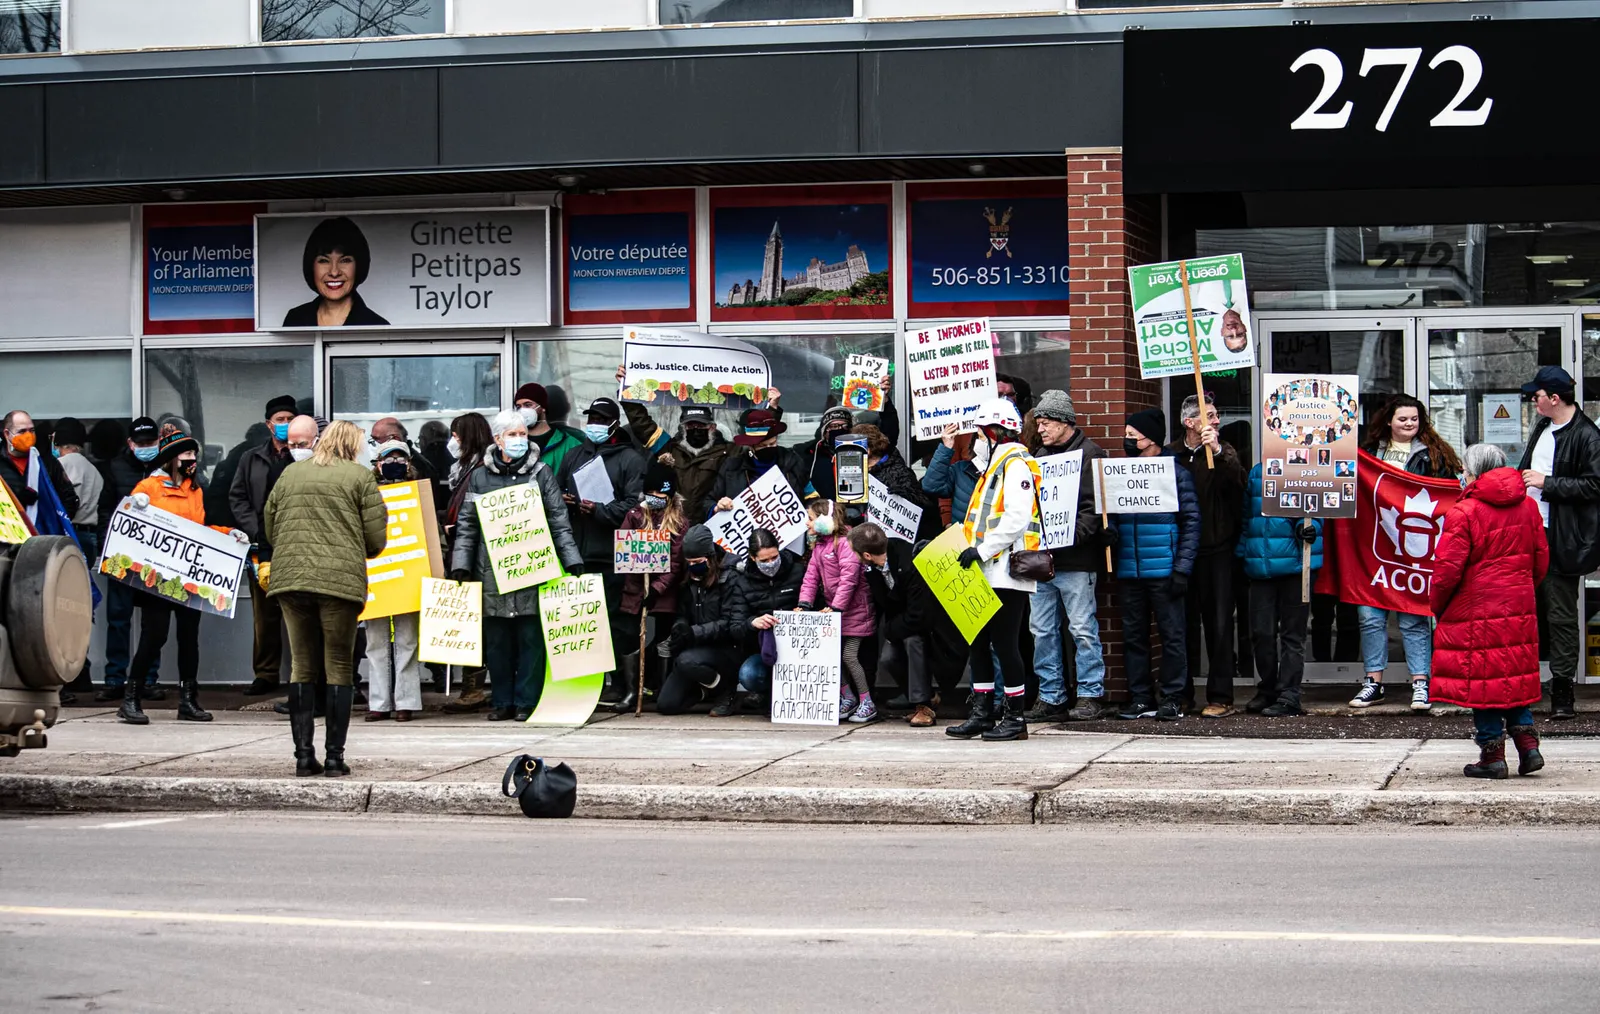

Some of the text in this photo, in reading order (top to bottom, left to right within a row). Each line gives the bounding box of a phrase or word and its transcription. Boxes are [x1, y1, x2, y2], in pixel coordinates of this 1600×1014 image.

[1289, 44, 1493, 132] 272
[410, 220, 513, 246] Ginette
[152, 244, 254, 262] Your Membe
[570, 242, 687, 263] Votre députée
[1374, 241, 1454, 279] 272
[153, 263, 255, 280] of Parliament
[412, 252, 521, 283] Petitpas
[573, 266, 686, 278] MONCTON RIVERVIEW DIEPPE
[931, 265, 1069, 286] 506-851-3310
[1192, 263, 1229, 279] green
[1148, 273, 1174, 287] vert
[152, 284, 254, 294] MONCTON RIVERVIEW DIEPP
[409, 283, 493, 317] Taylor
[918, 320, 987, 344] BE INFORMED!
[909, 339, 990, 363] CLIMATE CHANGE IS REAL
[629, 361, 764, 375] Jobs. Justice. Climate Action.
[851, 355, 863, 366] Il
[866, 359, 883, 372] n'y
[923, 359, 990, 381] LISTEN TO SCIENCE
[861, 370, 880, 380] pas
[952, 381, 962, 392] OUT
[963, 380, 970, 390] OF
[857, 390, 868, 405] B
[1295, 401, 1327, 410] Justice
[918, 409, 931, 420] The
[933, 406, 952, 417] choice
[954, 405, 960, 414] is
[1289, 411, 1332, 420] pour tous
[921, 425, 932, 437] YOU
[1103, 463, 1165, 476] ONE EARTH
[1301, 468, 1318, 477] pas
[1127, 479, 1149, 490] ONE
[1283, 478, 1309, 488] juste
[480, 488, 540, 509] COME ON
[1052, 485, 1058, 501] A
[773, 484, 806, 524] JOBS
[876, 489, 888, 503] CAN
[888, 498, 919, 523] CONTINUE
[1117, 496, 1161, 507] CHANCE
[757, 492, 793, 529] JUST
[503, 519, 531, 535] JUST
[882, 513, 894, 528] THE
[895, 523, 914, 540] FACTS
[1044, 511, 1070, 527] GREEN
[616, 528, 671, 542] LA TERRE
[616, 542, 624, 552] A
[497, 546, 552, 570] KEEP YOUR
[616, 552, 629, 563] DE
[188, 565, 235, 592] ACTION.
[943, 568, 976, 602] JOBS
[1370, 564, 1432, 597] ACO
[432, 581, 470, 598] EARTH
[543, 578, 595, 600] IMAGINE
[436, 597, 469, 610] NEEDS
[545, 600, 602, 622] WE STOP
[425, 607, 480, 622] THINKERS
[798, 613, 832, 626] GREENHOUSE
[443, 629, 461, 638] NOT
[548, 620, 598, 641] BURNING
[774, 625, 786, 637] GAS
[788, 625, 818, 637] EMISSIONS
[430, 637, 477, 651] DENIERS
[552, 638, 594, 655] STUFF
[791, 637, 821, 649] BY 2030
[798, 649, 809, 660] OR
[774, 663, 838, 684] IRREVERSIBLE
[782, 682, 829, 702] CLIMATE
[772, 701, 835, 721] CATASTROPHE
